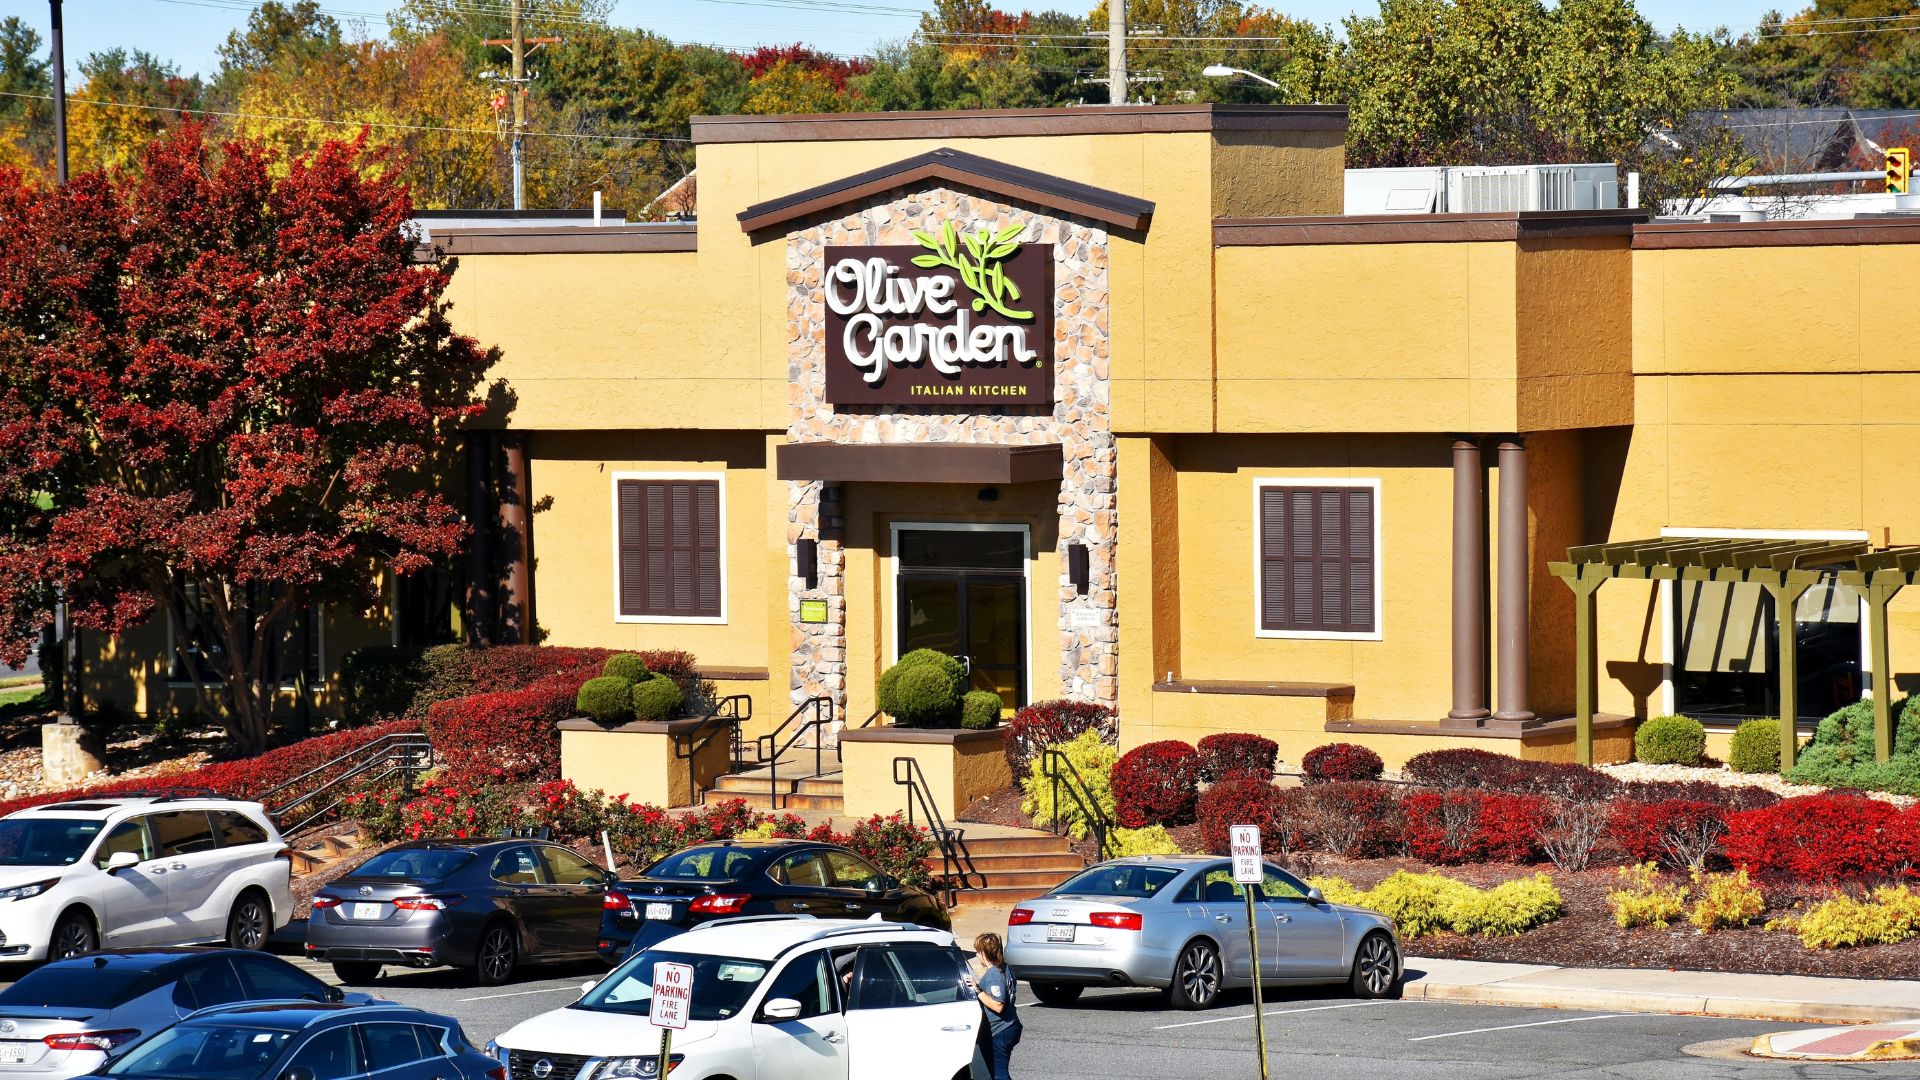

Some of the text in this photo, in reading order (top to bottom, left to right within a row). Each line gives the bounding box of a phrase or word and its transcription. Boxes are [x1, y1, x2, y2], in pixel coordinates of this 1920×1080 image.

[825, 257, 958, 315] Olive
[843, 308, 1037, 383] Garden
[911, 385, 1028, 396] ITALIAN KITCHEN
[1239, 832, 1251, 843] NO
[1234, 845, 1259, 856] PARKING
[1241, 858, 1253, 866] FIRE
[1241, 867, 1255, 875] LANE
[666, 971, 681, 984] NO
[655, 983, 688, 1000] PARKING
[662, 999, 679, 1010] FIRE
[660, 1009, 679, 1020] LANE
